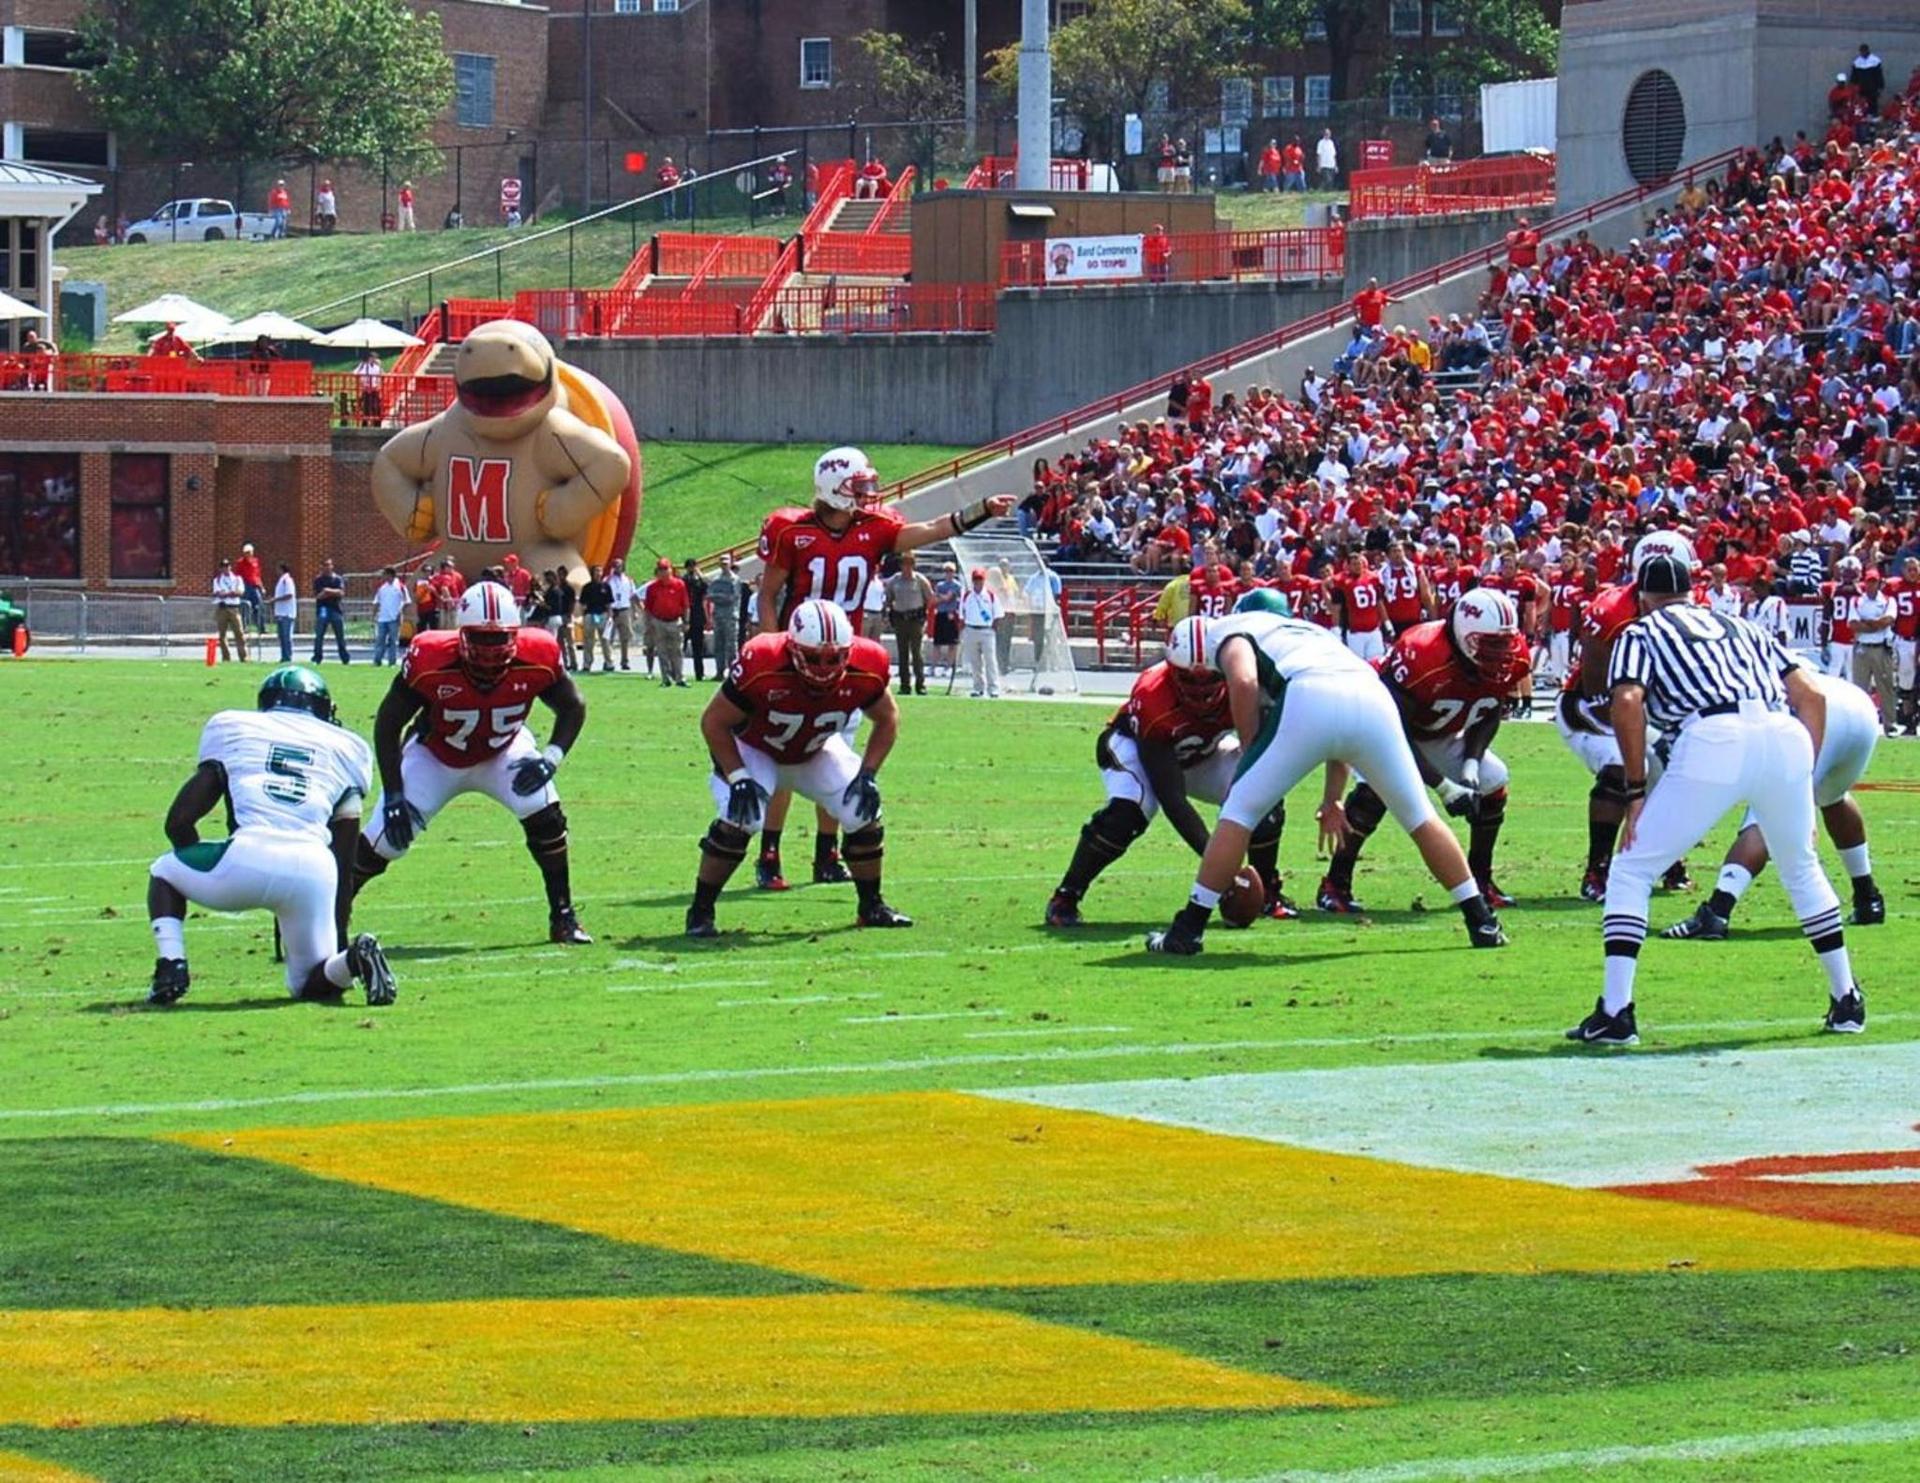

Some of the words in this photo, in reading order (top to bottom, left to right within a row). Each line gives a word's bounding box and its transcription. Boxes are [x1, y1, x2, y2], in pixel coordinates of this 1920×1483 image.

[1087, 260, 1099, 269] GO
[447, 453, 512, 544] M
[808, 555, 868, 612] 10
[1201, 594, 1225, 618] 32
[1353, 584, 1378, 609] 61
[443, 703, 527, 751] 75
[762, 709, 849, 753] 72
[264, 742, 317, 806] 5
